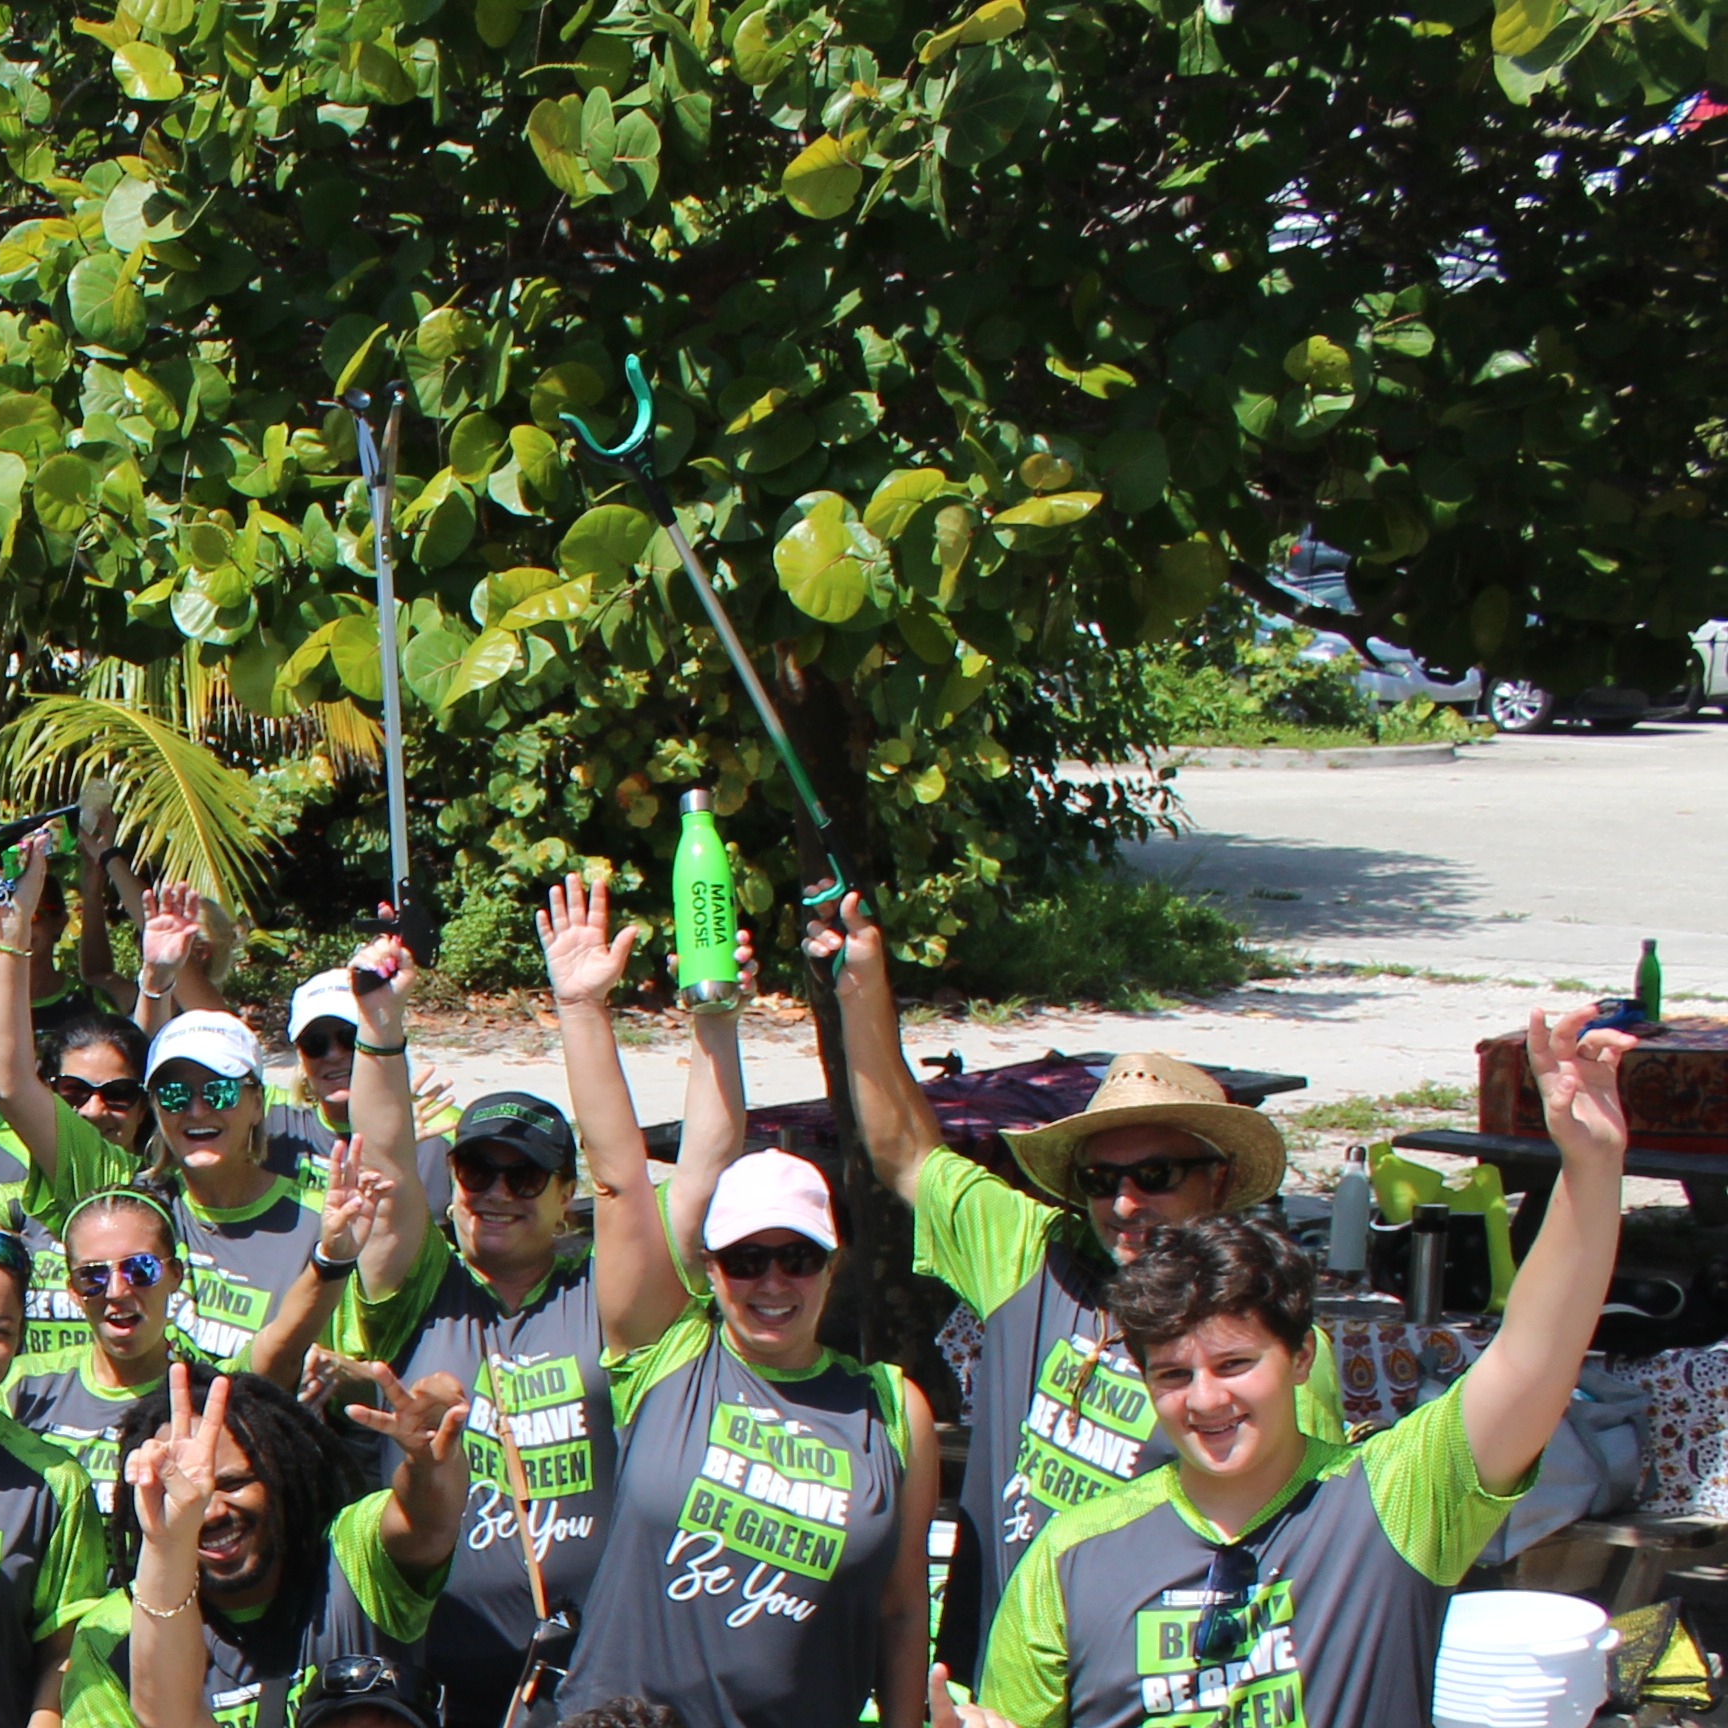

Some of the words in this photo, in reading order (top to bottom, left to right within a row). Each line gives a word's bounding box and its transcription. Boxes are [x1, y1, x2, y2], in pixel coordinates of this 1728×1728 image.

[691, 881, 709, 949] GOOSE
[710, 884, 728, 945] MAMA
[39, 1258, 65, 1281] BE
[197, 1278, 254, 1317] KIND
[30, 1330, 52, 1354] BE
[1027, 1392, 1060, 1438] BE
[469, 1443, 498, 1477] BE
[728, 1415, 763, 1449] BE
[767, 1434, 836, 1478] KIND
[701, 1446, 746, 1488] BE
[744, 1463, 849, 1526] BRAVE
[463, 1479, 520, 1550] Be
[527, 1500, 594, 1562] You
[688, 1489, 733, 1533] BE
[734, 1508, 837, 1570] GREEN
[665, 1530, 735, 1601] Be
[726, 1562, 818, 1628] You
[1141, 1675, 1194, 1714] BE
